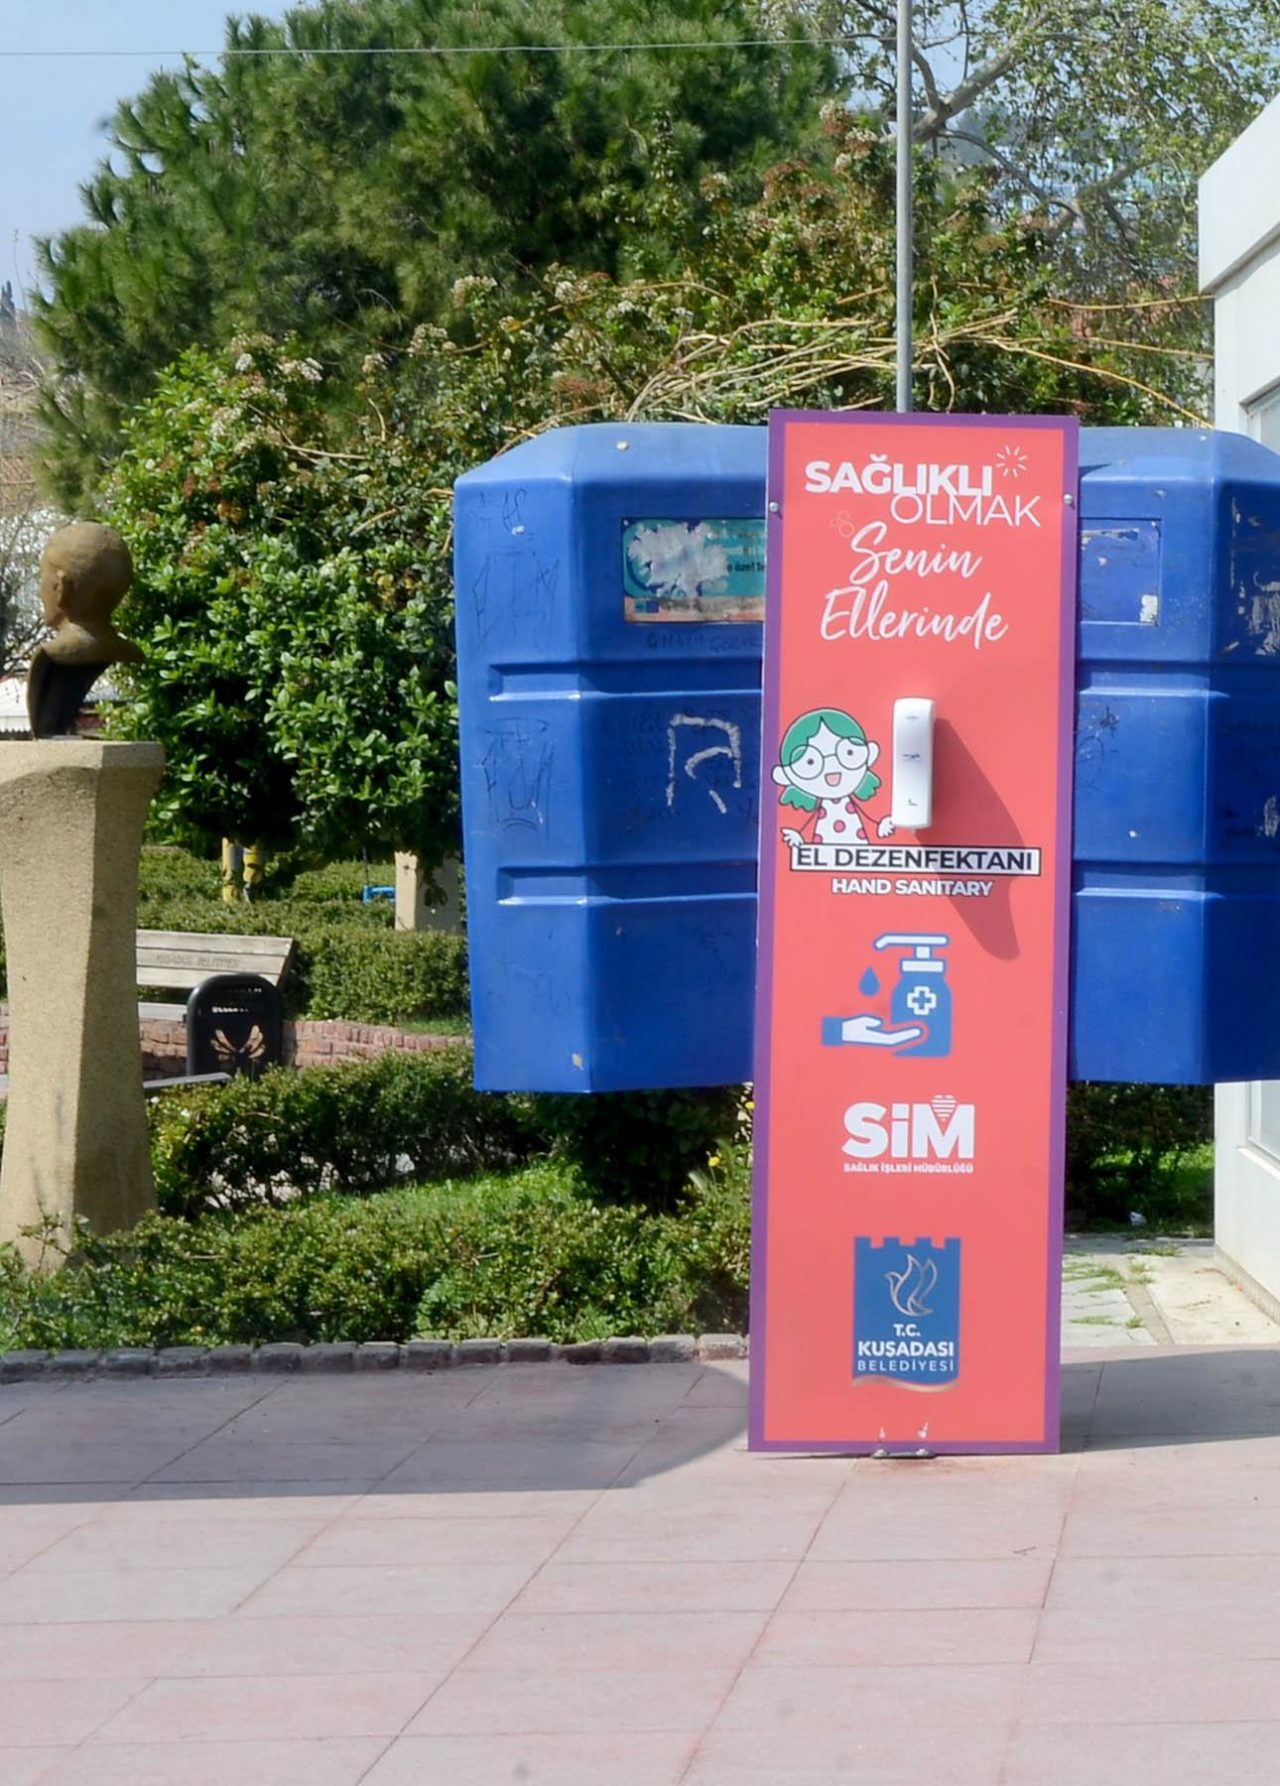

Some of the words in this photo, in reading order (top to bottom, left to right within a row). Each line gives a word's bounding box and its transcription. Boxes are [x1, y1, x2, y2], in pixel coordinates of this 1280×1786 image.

[804, 454, 992, 496] SAĞLIKLI
[890, 493, 1041, 527] OLMAK
[849, 521, 982, 586] Senin
[820, 580, 1008, 650] Ellerinde
[797, 848, 827, 868] EL
[835, 848, 1033, 871] DEZENFEKTANI
[832, 878, 892, 895] HAND
[895, 879, 994, 897] SANITARY
[893, 1323, 921, 1338] T.C.
[858, 1341, 954, 1358] KUŞADASI
[857, 1359, 955, 1373] BELEDİYESİ
